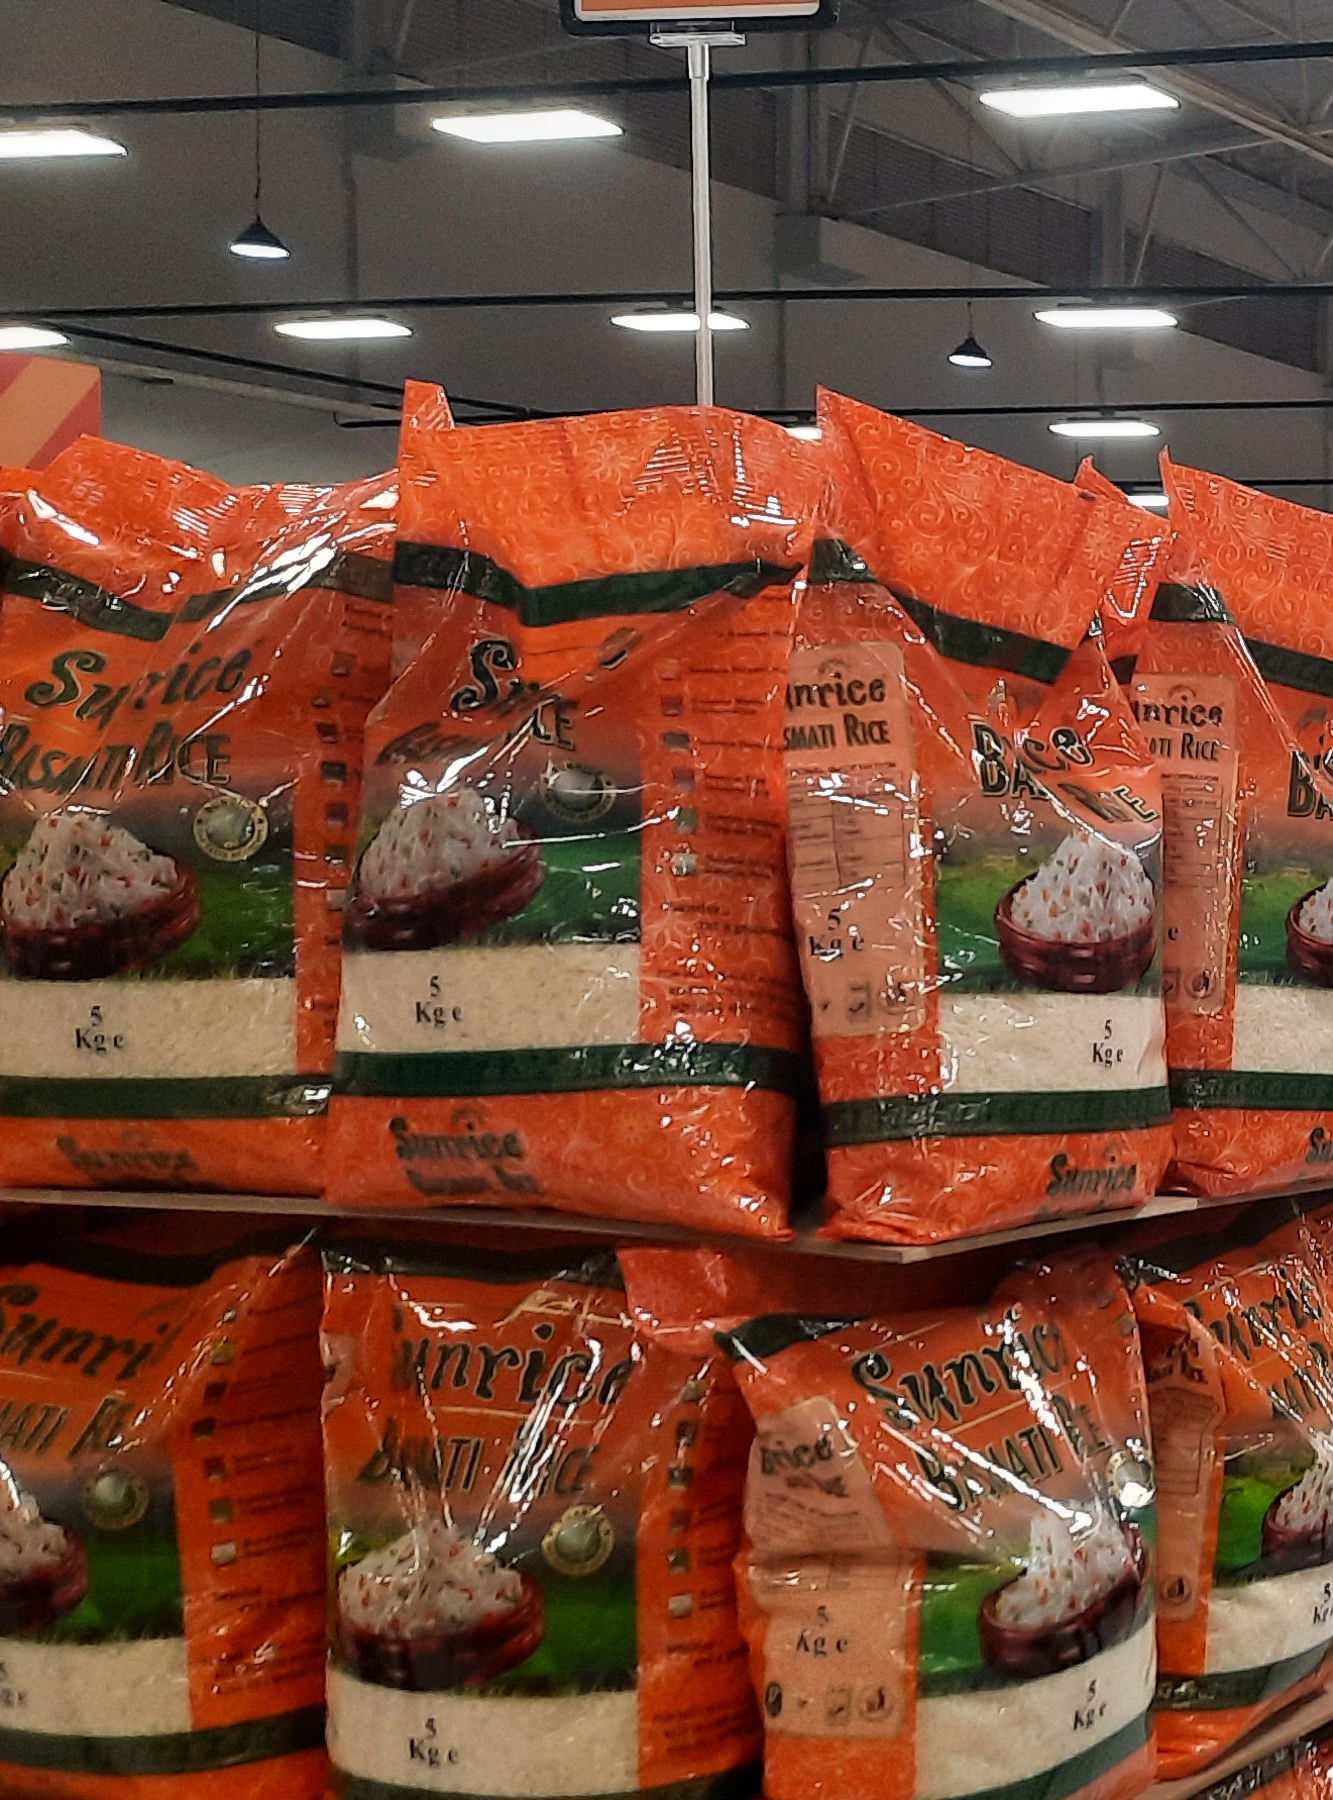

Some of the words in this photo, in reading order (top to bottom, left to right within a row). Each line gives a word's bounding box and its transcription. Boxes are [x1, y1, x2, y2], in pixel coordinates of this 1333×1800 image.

[784, 722, 836, 751] SMATI
[843, 713, 891, 745] RICE
[1180, 732, 1219, 761] RICE
[428, 975, 442, 997] 5
[88, 1006, 103, 1028] 5
[414, 999, 447, 1025] Kg
[74, 1028, 108, 1053] Kg
[1103, 1019, 1113, 1040] 5
[1092, 1042, 1113, 1068] Kg
[1046, 1153, 1137, 1196] Sunrice
